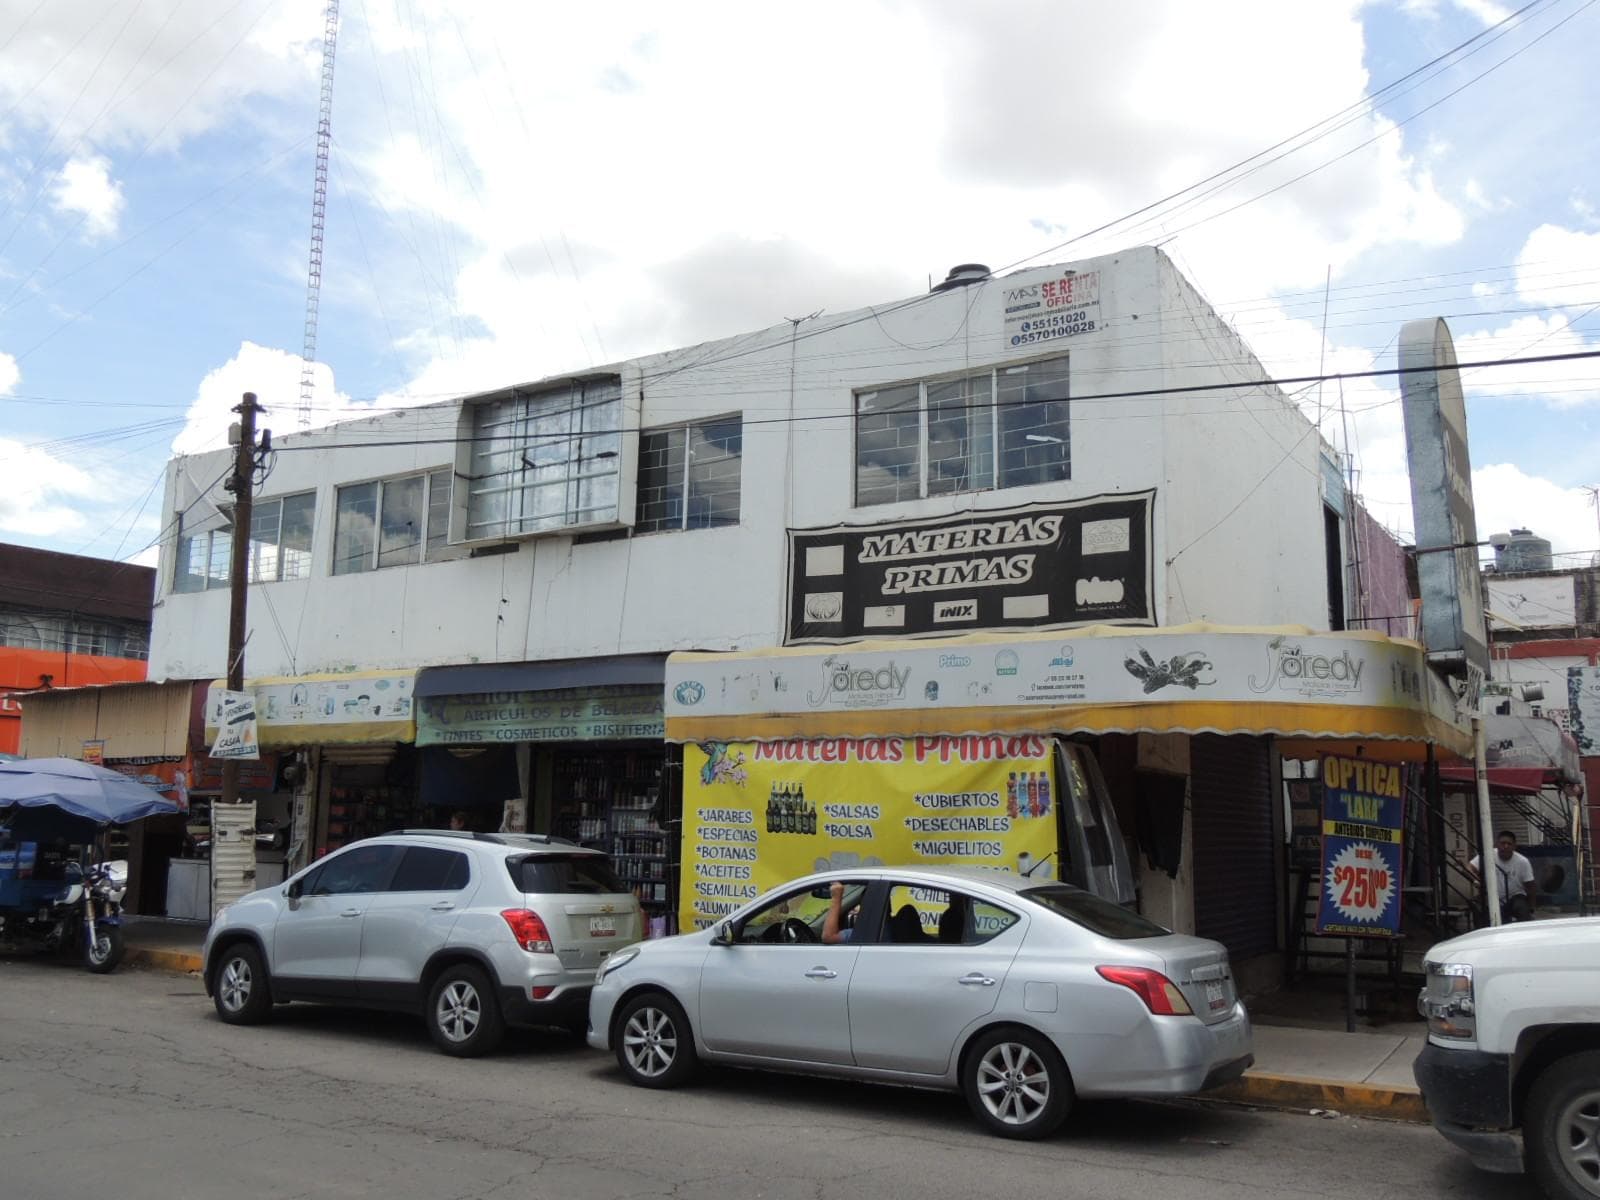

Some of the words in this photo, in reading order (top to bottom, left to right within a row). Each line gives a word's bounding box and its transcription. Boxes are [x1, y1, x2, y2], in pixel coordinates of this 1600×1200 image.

[1042, 281, 1056, 298] SE
[1032, 311, 1086, 330] 55151020
[1021, 321, 1095, 344] 5570100028
[858, 516, 1063, 563] MATERIAS
[881, 554, 1036, 594] PRIMAS
[939, 605, 973, 618] INIX
[939, 654, 971, 668] Primo
[464, 706, 551, 722] ARTICULOS
[560, 706, 581, 718] DE
[592, 702, 664, 716] BELLEZA
[755, 738, 903, 762] Materias
[915, 735, 1046, 762] Primas
[1324, 756, 1400, 798] OPTICA
